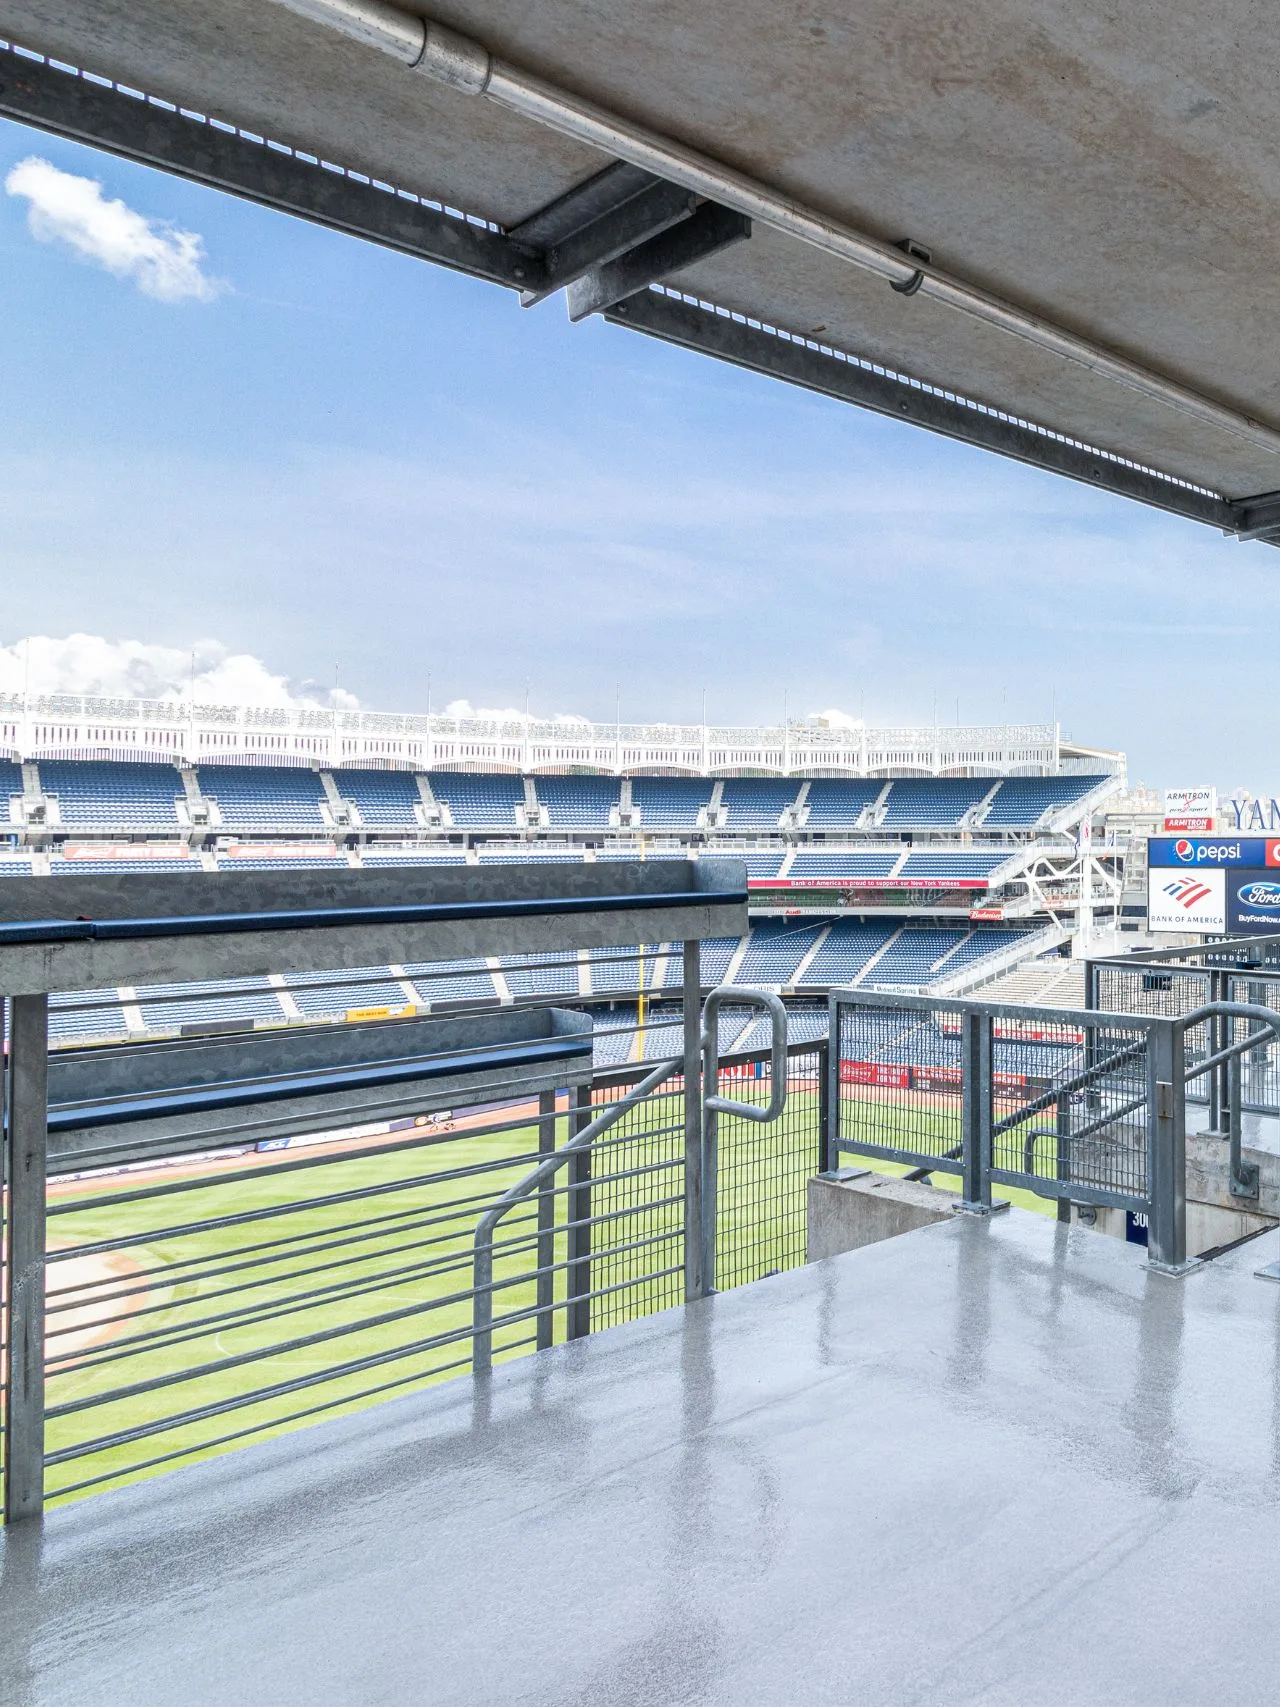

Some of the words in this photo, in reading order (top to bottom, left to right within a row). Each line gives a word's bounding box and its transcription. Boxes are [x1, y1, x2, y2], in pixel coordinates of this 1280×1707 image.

[1167, 792, 1210, 800] ARMITRON
[1168, 819, 1208, 827] ARMITRON
[1196, 843, 1241, 862] pepsi
[849, 880, 867, 888] proud
[876, 880, 899, 888] support
[1187, 916, 1224, 924] AMERICA
